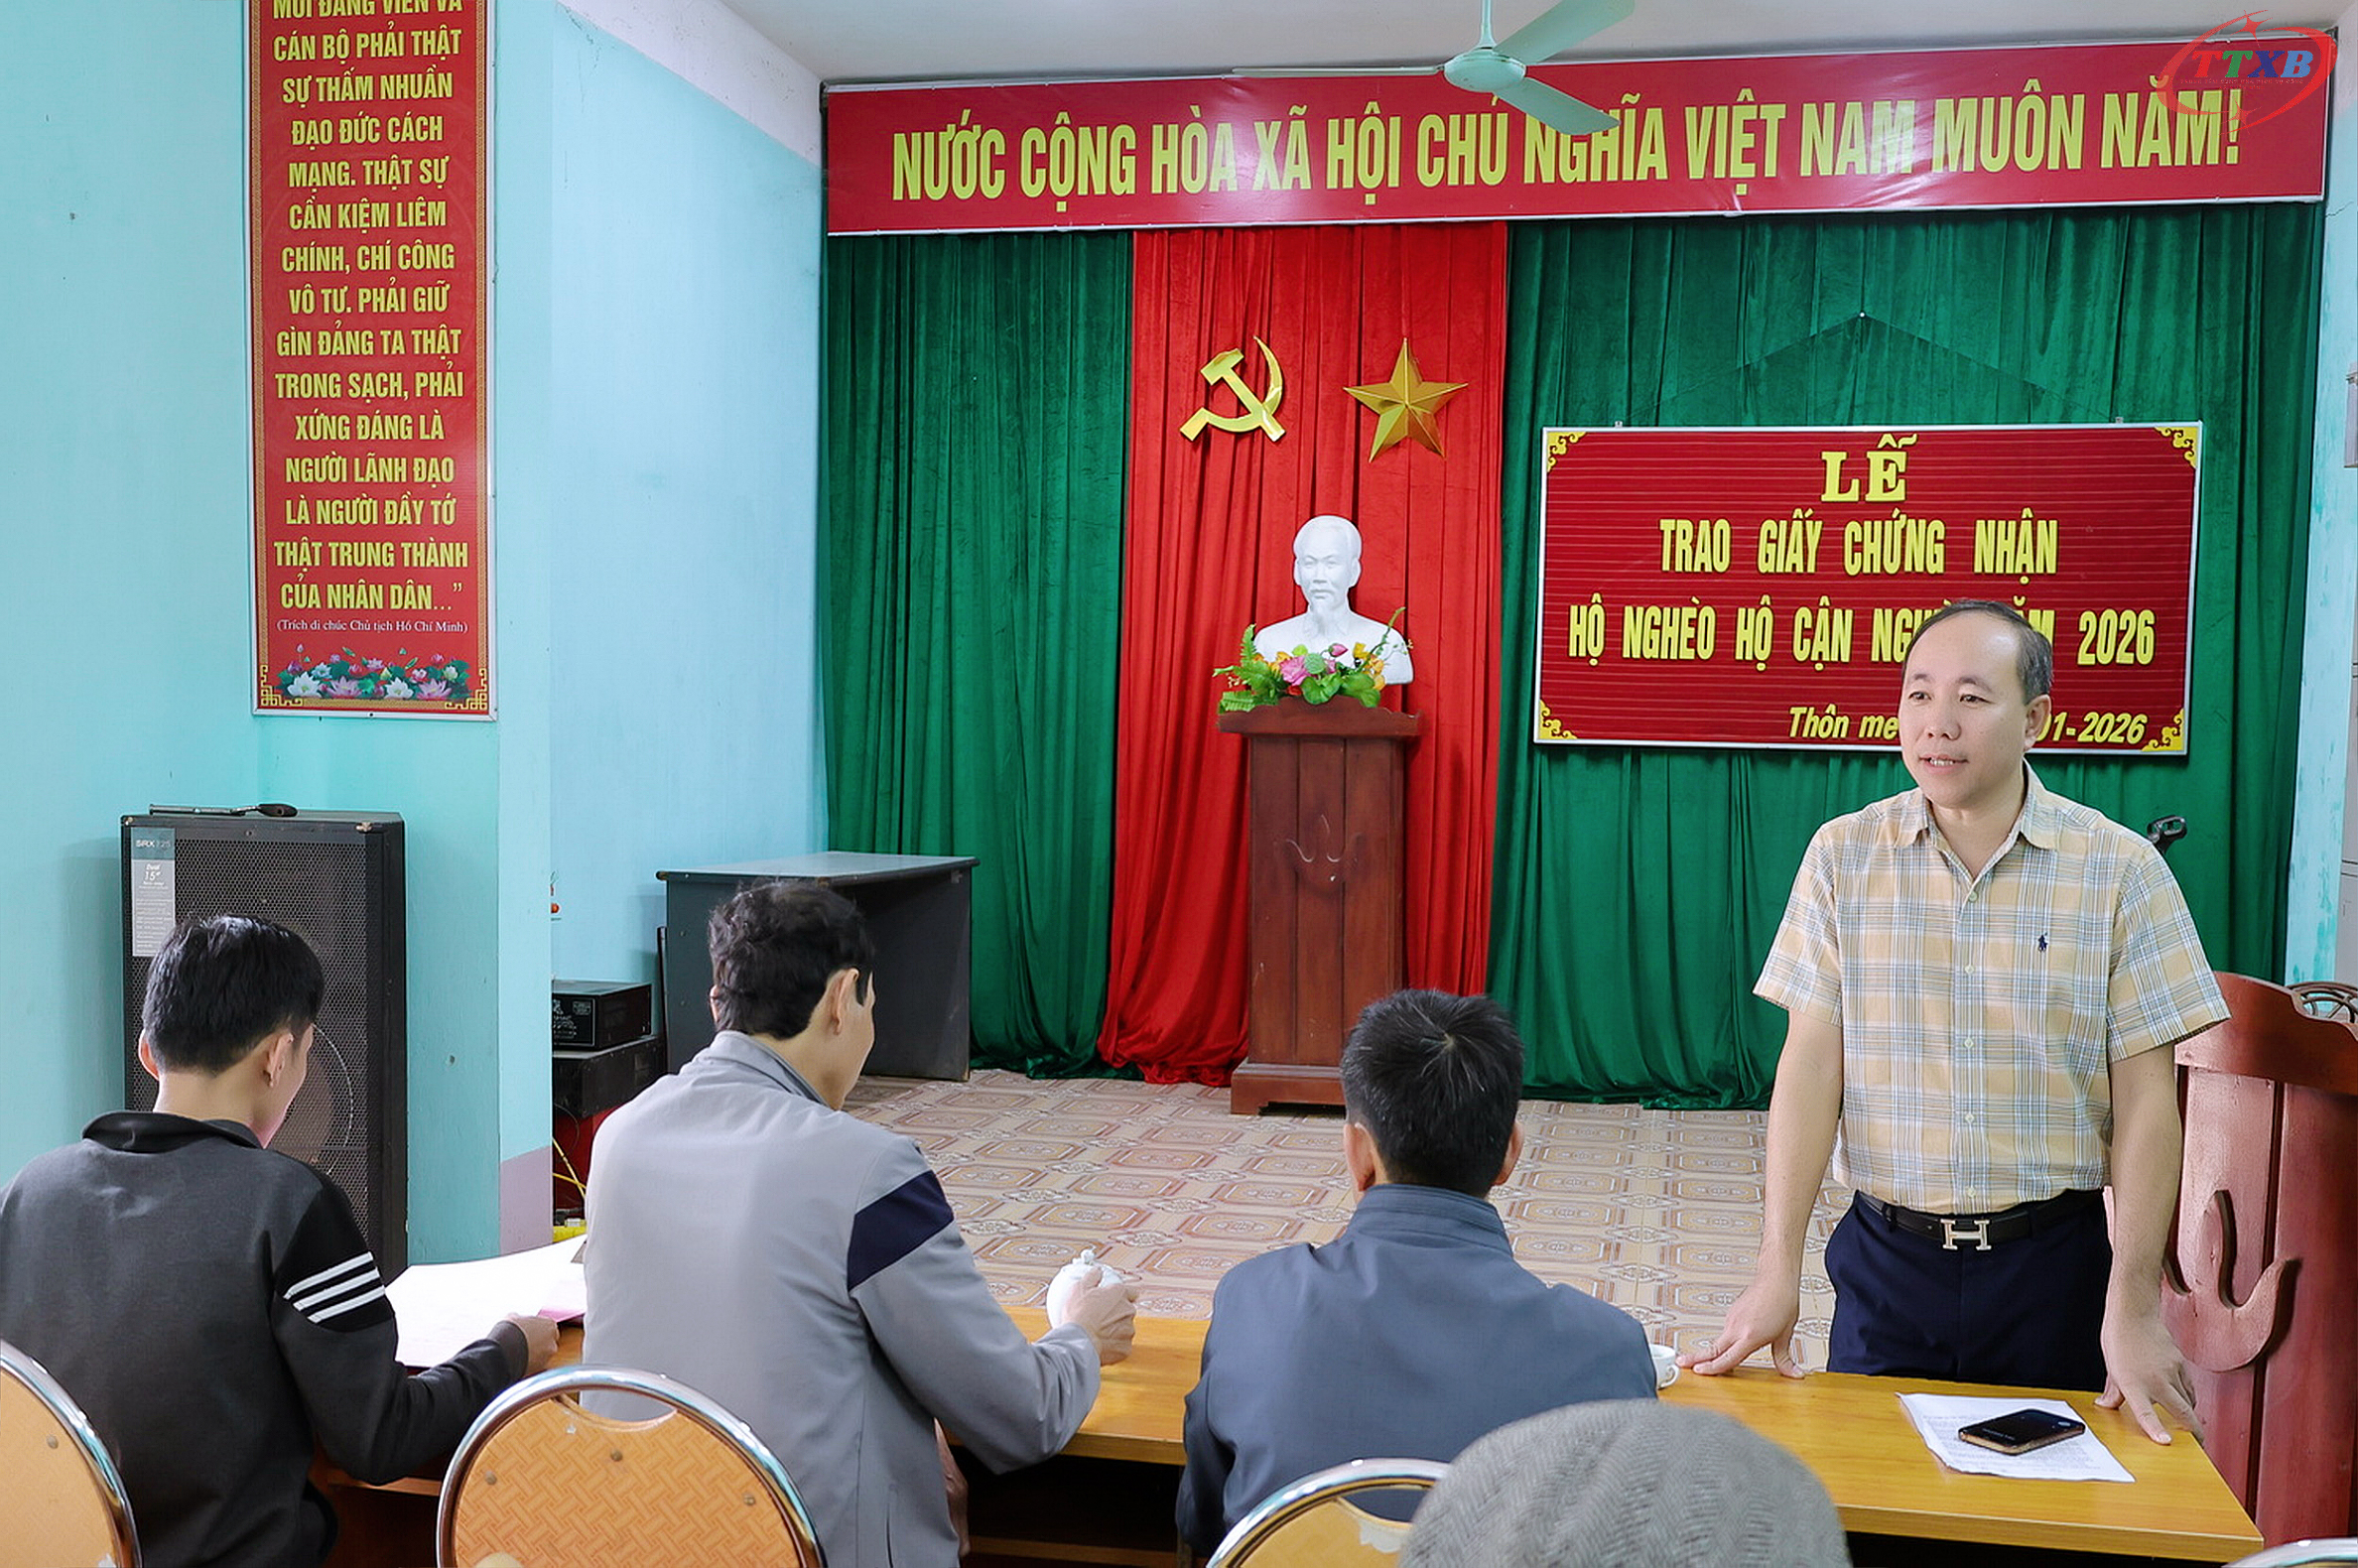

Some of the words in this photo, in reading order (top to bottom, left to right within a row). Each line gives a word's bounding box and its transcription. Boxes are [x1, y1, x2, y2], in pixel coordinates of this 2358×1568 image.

[273, 31, 316, 62] CÁN
[322, 28, 350, 65] BỘ
[356, 20, 405, 59] PHẢI
[410, 24, 462, 62] THẬT
[282, 75, 313, 108] SỰ
[315, 66, 374, 102] THẤM
[380, 65, 453, 100] NHUẦN
[291, 119, 333, 151] ĐẠO
[338, 110, 381, 144] ĐỨC
[387, 111, 443, 143] CÁCH
[892, 108, 1005, 200] NƯỚC
[1020, 111, 1136, 212] CỘNG
[1150, 104, 1237, 195] HÒA
[1253, 104, 1312, 191] XÃ
[1326, 101, 1401, 205] HỘI
[1523, 92, 1668, 185] NGHĨA
[1684, 87, 1786, 196] VIỆT
[1799, 99, 1916, 177] NAM
[1931, 78, 2085, 173] MUÔN
[2100, 74, 2242, 169] NĂM!
[289, 161, 356, 194] MẠNG.
[361, 154, 414, 191] THẬT
[419, 155, 451, 190] SỰ
[289, 195, 331, 230] CẦN
[337, 197, 390, 234] KIỆM
[396, 196, 447, 227] LIÊM
[282, 241, 350, 274] CHÍNH,
[356, 239, 391, 271] CHÍ
[397, 238, 455, 270] CÔNG
[288, 283, 316, 315] VÔ
[320, 285, 352, 314] TƯ.
[358, 276, 407, 314] PHẢI
[413, 280, 451, 313] GIỮ
[276, 326, 313, 357] GÌN
[317, 319, 374, 356] ĐẢNG
[379, 329, 406, 355] TA
[410, 323, 462, 360] THẬT
[274, 372, 341, 399] TRONG
[347, 372, 409, 404] SẠCH,
[415, 360, 463, 398] PHẢI
[295, 407, 350, 441] XỨNG
[355, 409, 413, 441] ĐÁNG
[419, 408, 445, 441] LÀ
[285, 450, 347, 483] NGƯỜI
[353, 452, 407, 483] LÃNH
[412, 457, 456, 488] ĐẠO
[1820, 433, 1917, 502] LỄ
[285, 494, 311, 525] LÀ
[316, 492, 378, 526] NGƯỜI
[383, 490, 425, 525] ĐẦY
[430, 492, 458, 526] TỚ
[273, 536, 324, 573] THẬT
[328, 541, 395, 568] TRUNG
[400, 536, 468, 568] THÀNH
[1659, 518, 1731, 573] TRAO
[1758, 507, 1823, 574] GIẤY
[1844, 507, 1946, 576] CHỨNG
[1973, 507, 2058, 585] NHẬN
[280, 572, 322, 609] CỦA
[327, 578, 384, 609] NHÂN
[1568, 592, 1606, 667] HỘ
[1622, 595, 1716, 661] NGHÈO
[1735, 594, 1773, 672] HỘ
[1792, 595, 1854, 671] CẬN
[2077, 608, 2156, 666] 2026
[1789, 703, 1850, 739] Thôn
